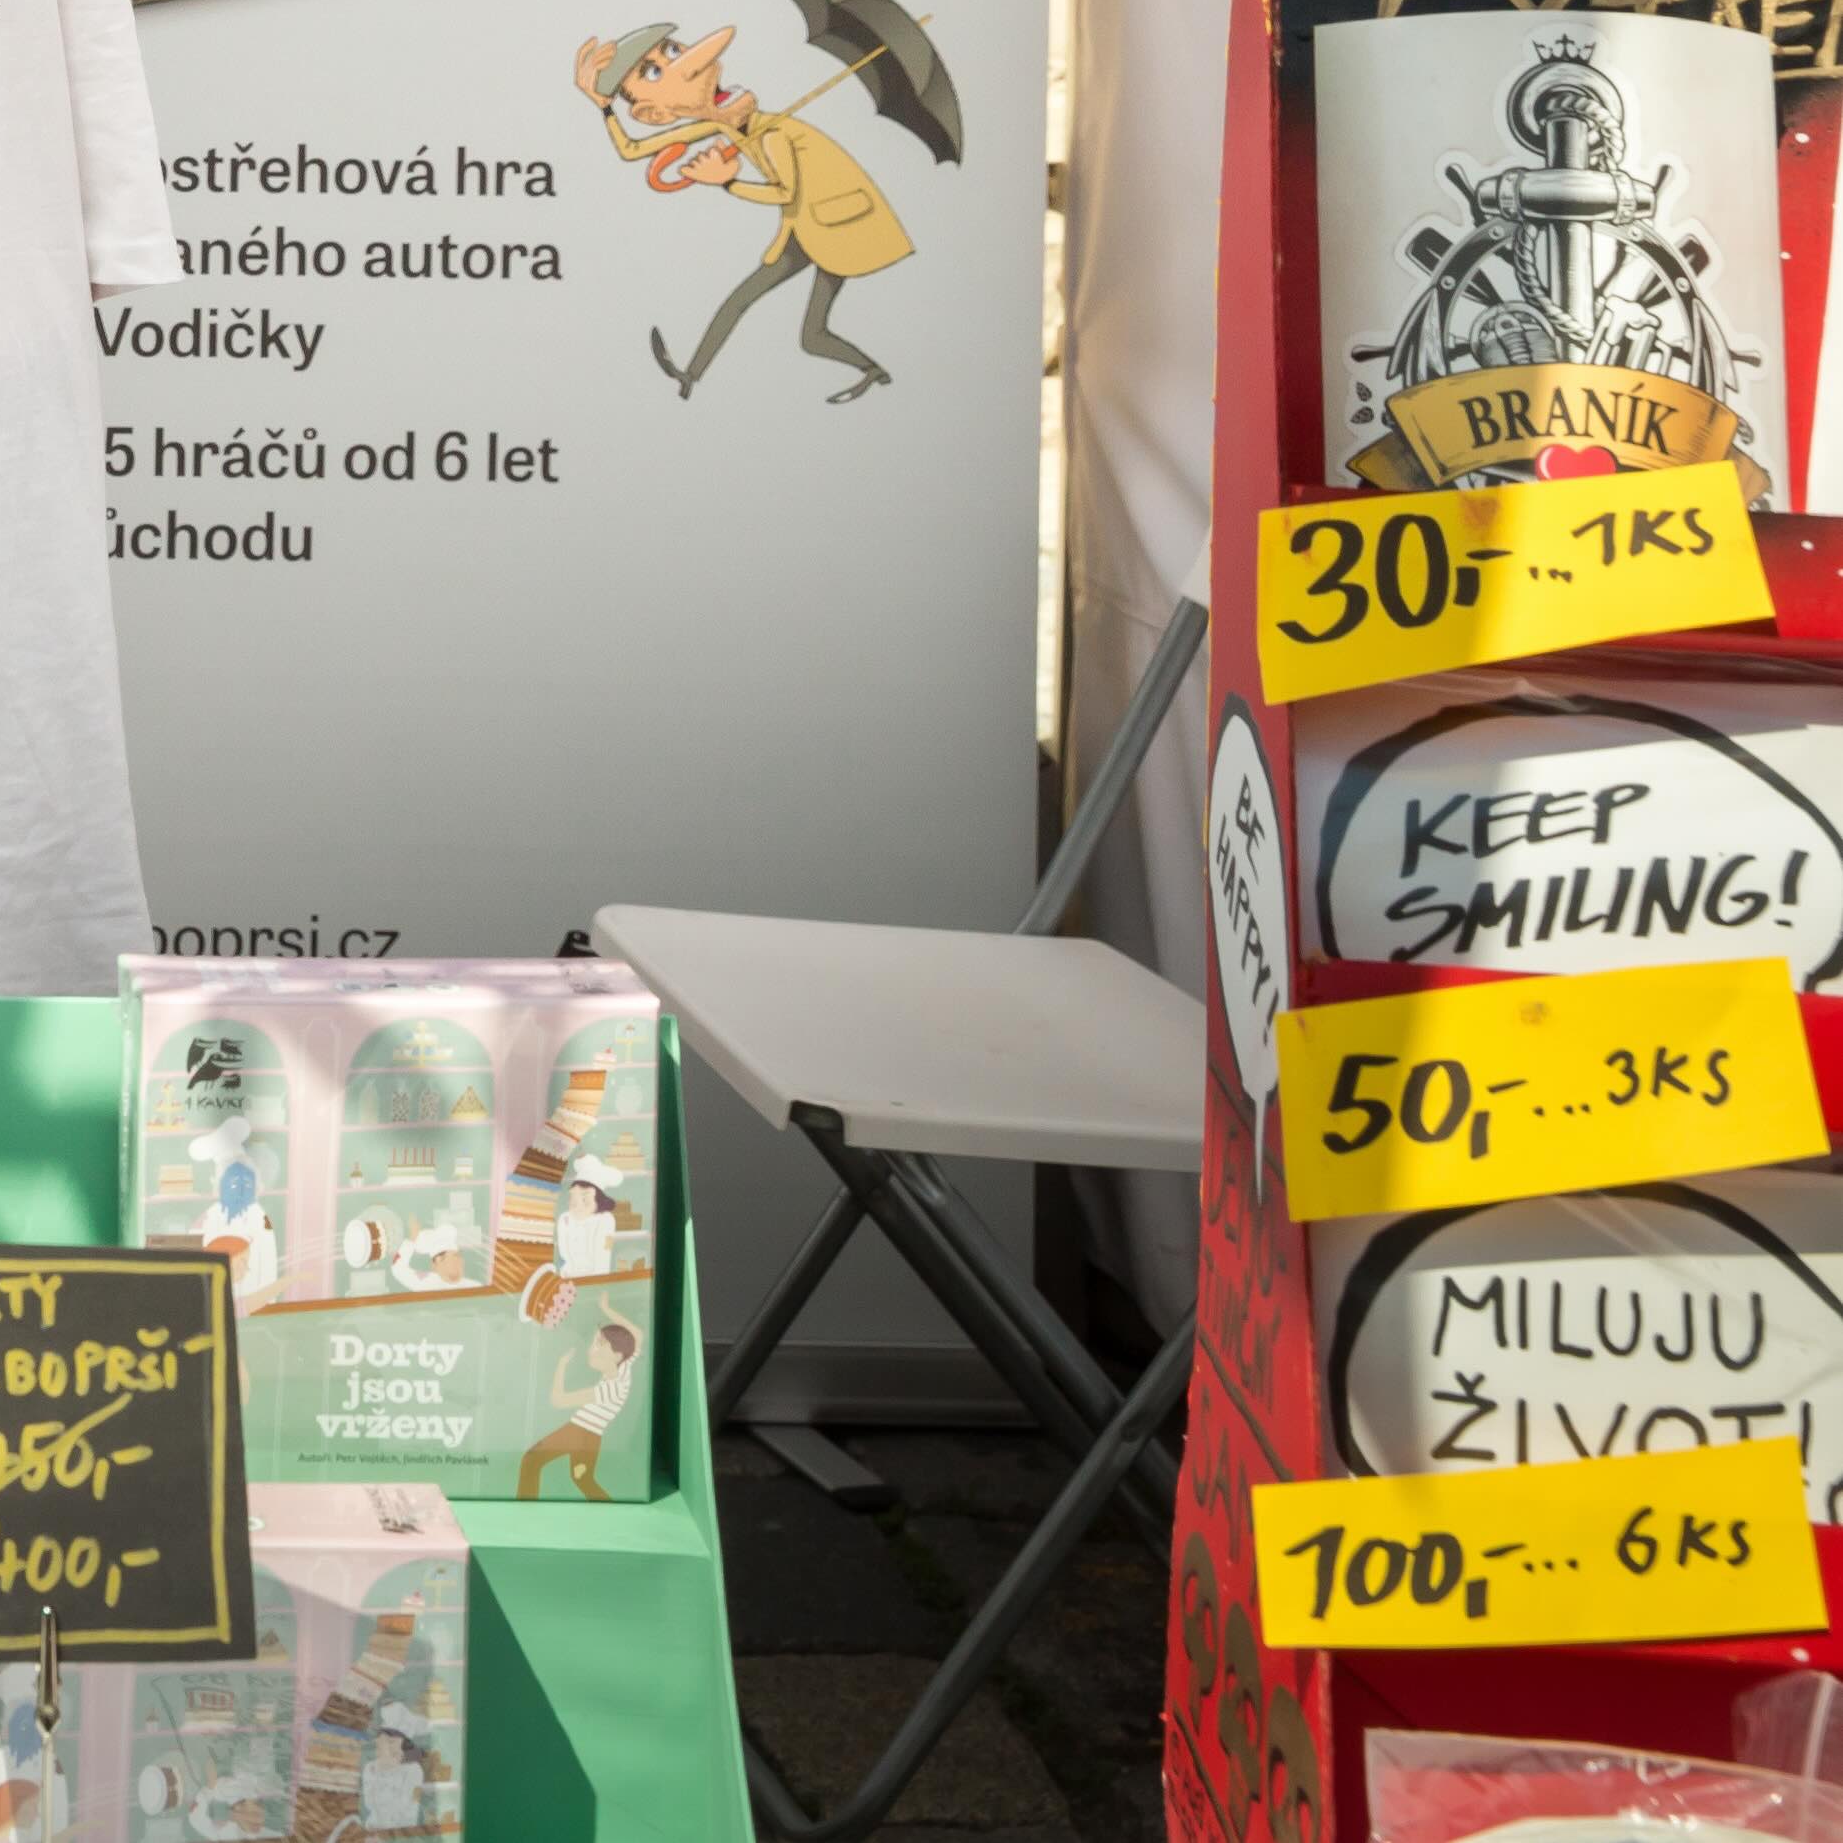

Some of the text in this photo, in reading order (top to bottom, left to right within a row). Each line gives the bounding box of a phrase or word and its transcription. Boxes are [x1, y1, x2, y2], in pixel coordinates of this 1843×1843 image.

[160, 142, 556, 197] střehová hra
[174, 225, 562, 280] aného autora
[93, 307, 326, 372] Vodičky
[1460, 379, 1681, 457] BRANÍK
[154, 426, 326, 479] hráčů
[343, 431, 415, 481] od
[435, 431, 468, 482] 6
[487, 432, 560, 483] let
[1400, 783, 1650, 878] KEEP
[1385, 850, 1810, 963] SMILING!
[1433, 1276, 1765, 1370] MILUJU
[329, 1334, 464, 1375] Dorty
[342, 1371, 444, 1411] jsou
[316, 1407, 473, 1448] vrženy
